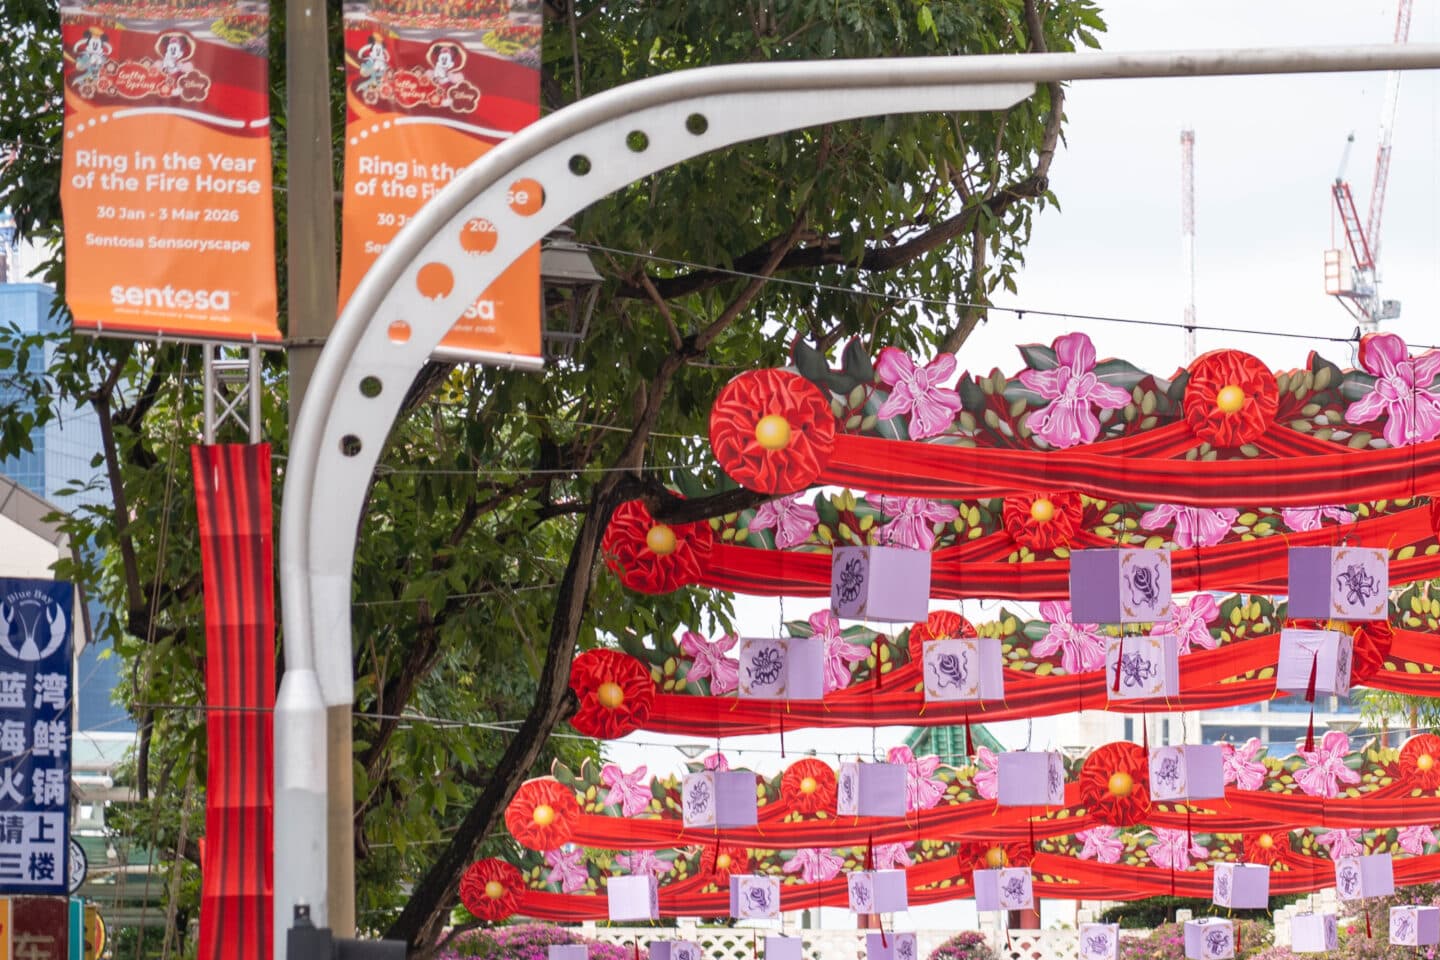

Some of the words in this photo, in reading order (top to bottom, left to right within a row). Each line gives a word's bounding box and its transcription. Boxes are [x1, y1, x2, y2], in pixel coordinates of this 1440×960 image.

[75, 149, 128, 174] Ring
[134, 151, 156, 170] in
[162, 152, 201, 171] the
[207, 153, 257, 172] Year
[358, 156, 407, 179] Ring
[412, 159, 427, 178] in
[71, 171, 95, 189] of
[100, 173, 139, 191] the
[146, 173, 190, 192] Fire
[196, 176, 261, 194] Horse
[354, 178, 377, 196] of
[381, 180, 418, 198] the
[96, 206, 115, 219] 30
[119, 207, 145, 220] Jan
[159, 207, 168, 220] 3
[171, 208, 201, 222] Mar
[203, 209, 240, 223] 2026
[376, 213, 395, 226] 30
[469, 219, 496, 233] 202
[85, 233, 144, 249] Sentosa
[147, 236, 251, 254] Sensoryscape
[110, 284, 231, 312] sentosa
[7, 590, 31, 604] Blue
[34, 589, 54, 605] Bay
[0, 671, 67, 710] 蓝湾
[0, 719, 67, 758] 海鲜
[0, 767, 65, 806] 火锅
[0, 815, 56, 845] 请上
[0, 851, 55, 881] 三楼
